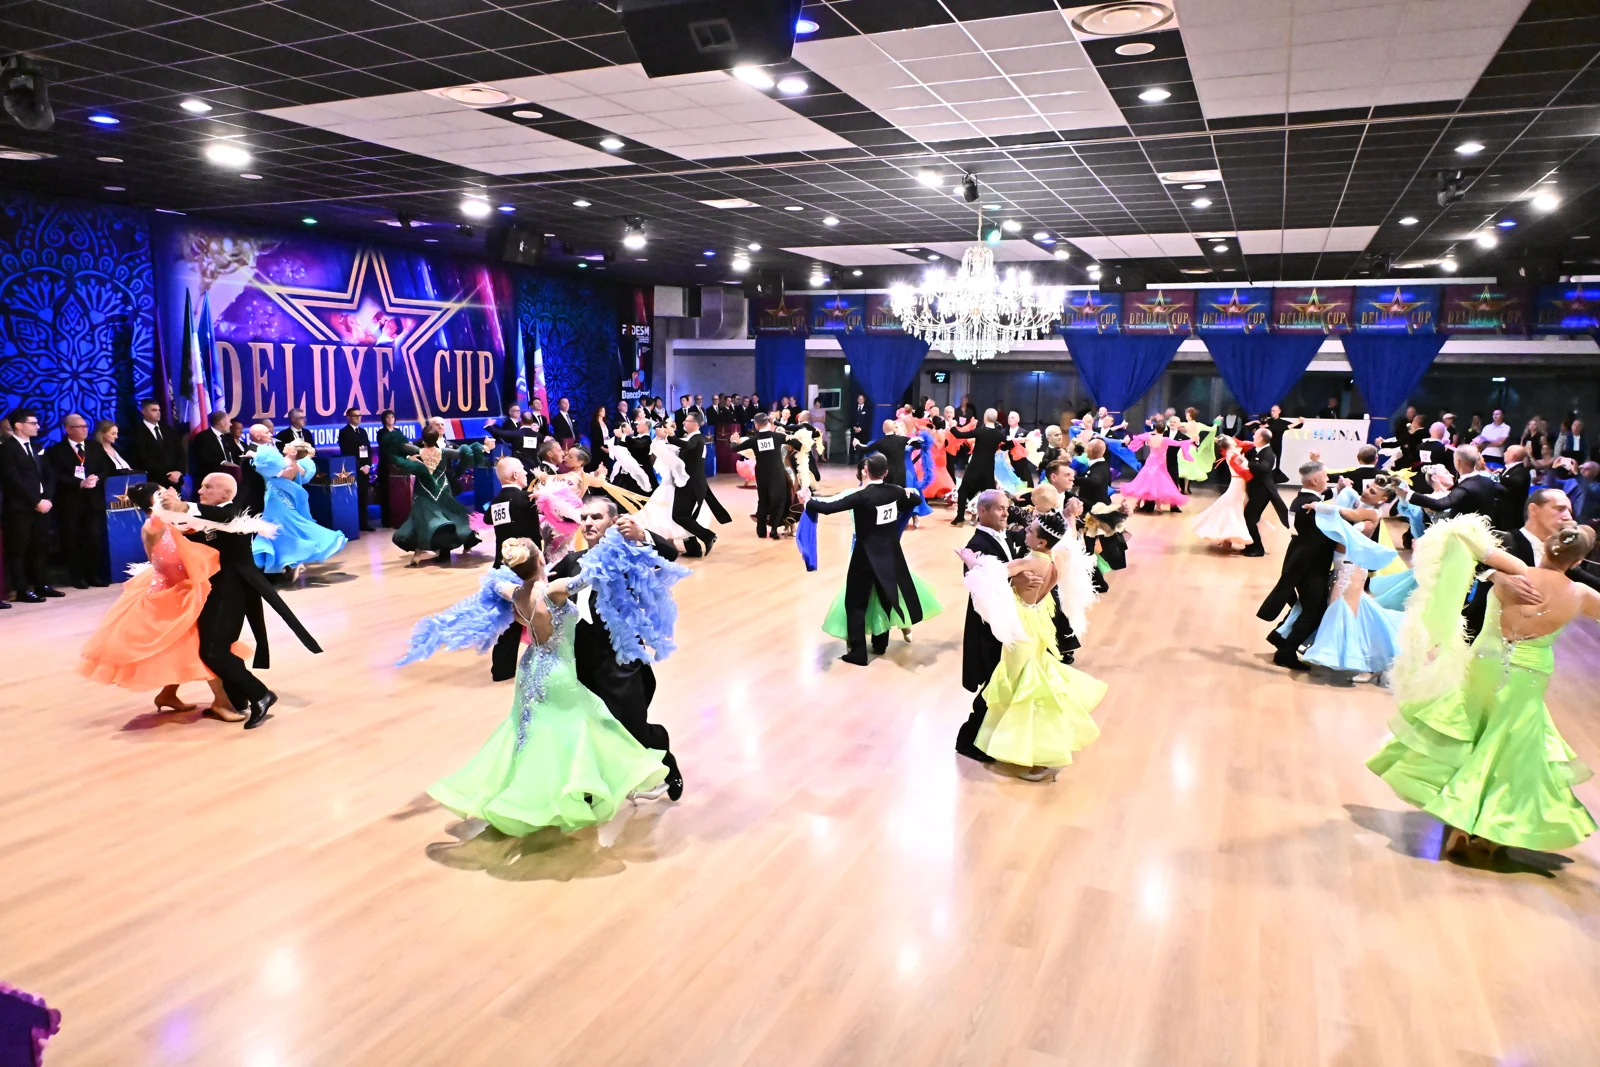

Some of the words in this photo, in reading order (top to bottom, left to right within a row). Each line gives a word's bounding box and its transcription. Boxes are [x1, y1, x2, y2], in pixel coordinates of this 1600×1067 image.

[1100, 312, 1117, 324] CUP
[1171, 312, 1189, 324] CUP
[1247, 312, 1265, 324] CUP
[1327, 312, 1346, 324] CUP
[1412, 311, 1432, 323] CUP
[215, 341, 396, 420] DELUXE
[434, 349, 494, 413] CUP
[1290, 429, 1361, 441] ATHENA
[760, 441, 771, 449] 301
[493, 508, 507, 521] 265
[883, 508, 893, 520] 27
